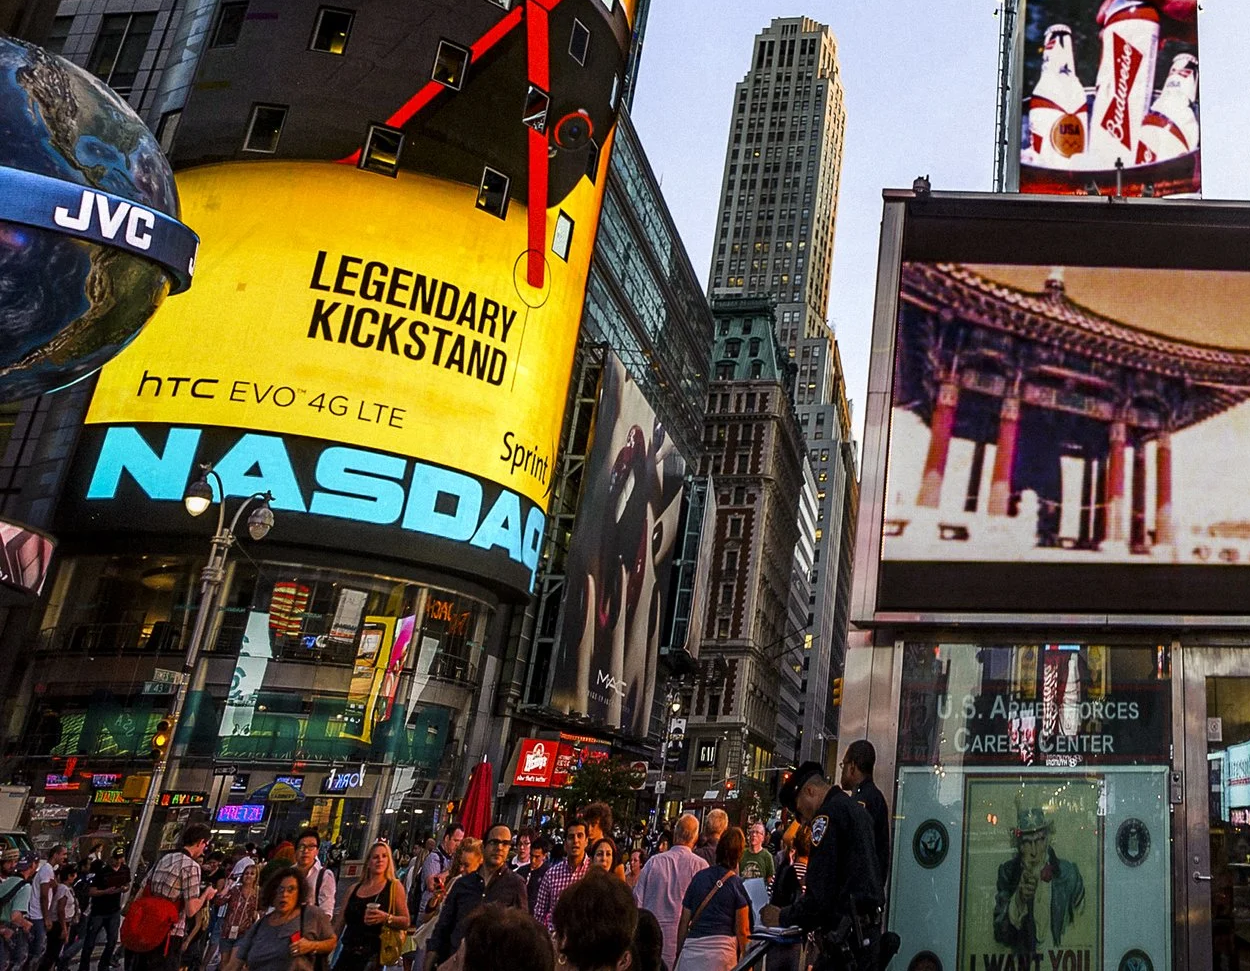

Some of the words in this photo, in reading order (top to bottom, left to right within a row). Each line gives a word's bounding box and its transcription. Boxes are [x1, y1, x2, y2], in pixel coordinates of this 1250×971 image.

[1107, 42, 1134, 143] Budweise
[1059, 124, 1080, 136] USA
[54, 191, 156, 252] JVC
[309, 250, 517, 344] LEGENDARY
[307, 298, 508, 388] KICKSTAND
[308, 393, 350, 418] 4G
[357, 399, 408, 430] LTE
[500, 431, 549, 486] Sprint
[86, 427, 546, 594] NASDAQ
[153, 682, 164, 690] 43
[937, 694, 983, 720] U.S.
[1064, 695, 1140, 720] ORCES
[1038, 727, 1114, 754] CENTER
[970, 953, 976, 971] I
[1048, 949, 1090, 971] YOU
